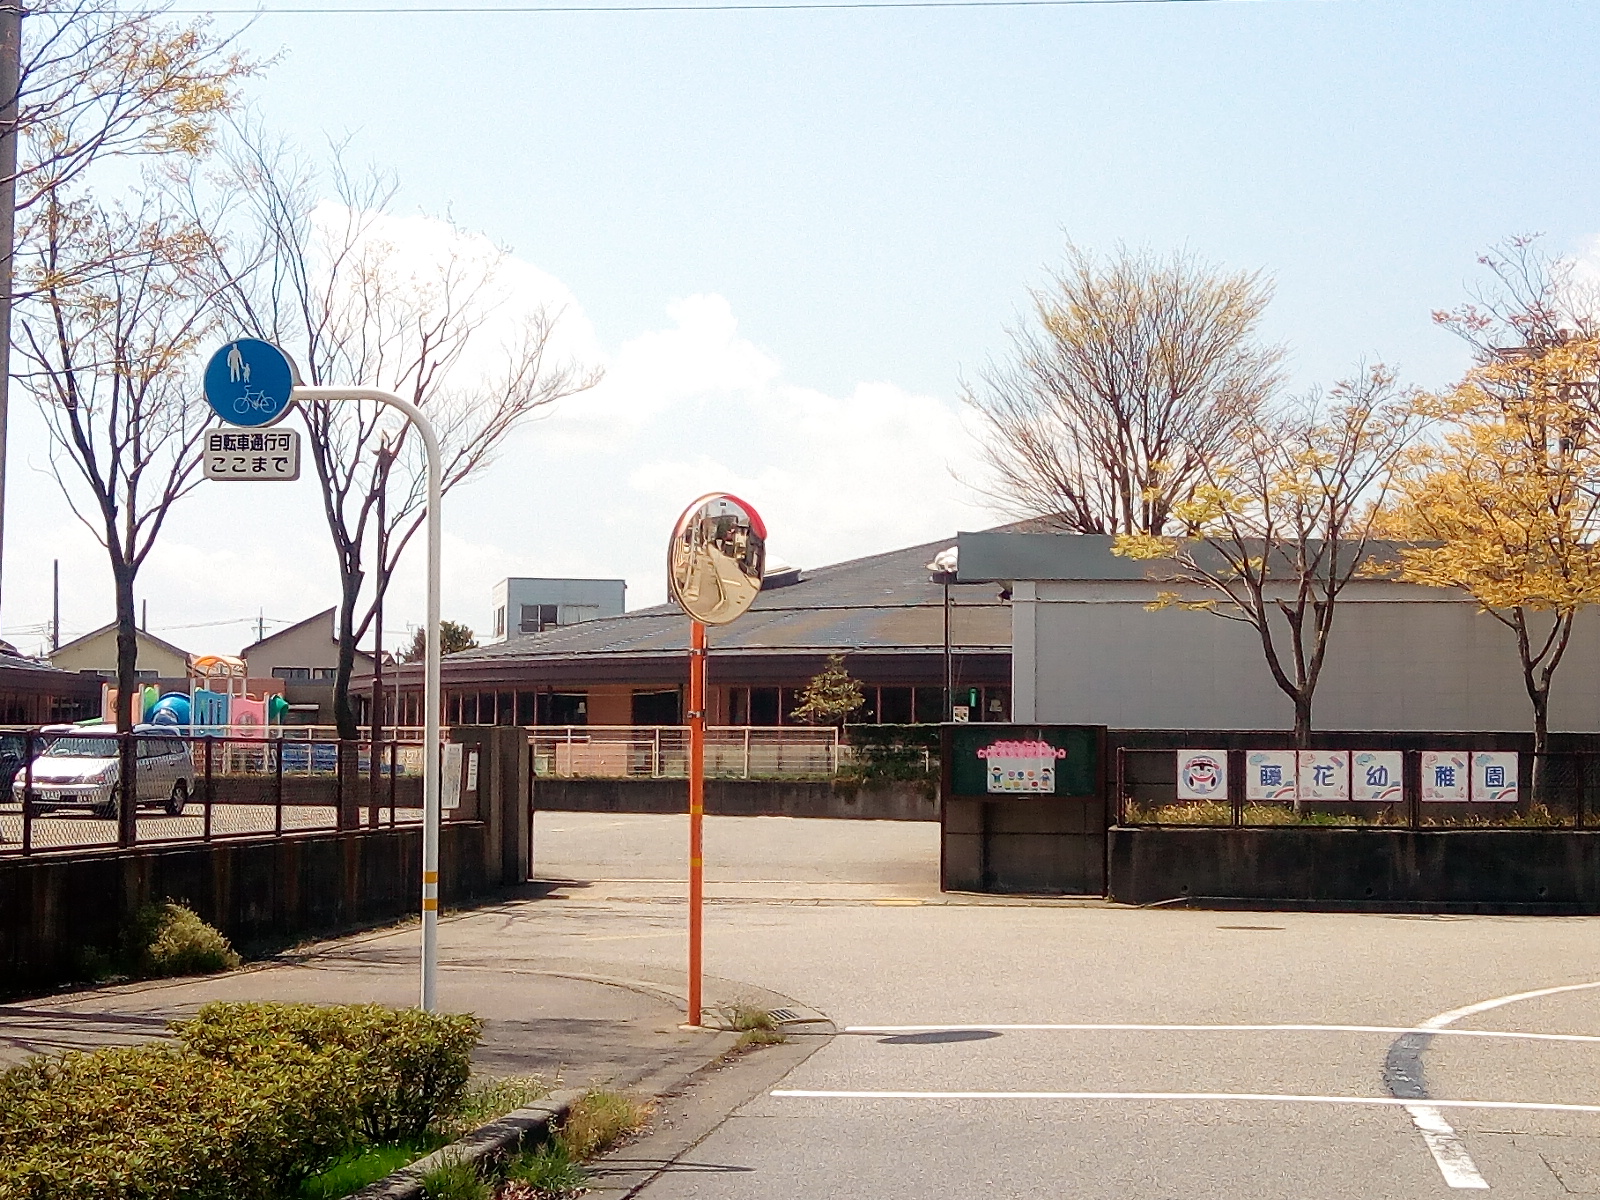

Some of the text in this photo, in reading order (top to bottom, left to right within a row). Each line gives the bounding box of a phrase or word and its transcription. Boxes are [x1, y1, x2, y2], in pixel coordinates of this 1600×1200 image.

[210, 434, 290, 452] 自転車通行可
[212, 457, 288, 472] ここまで
